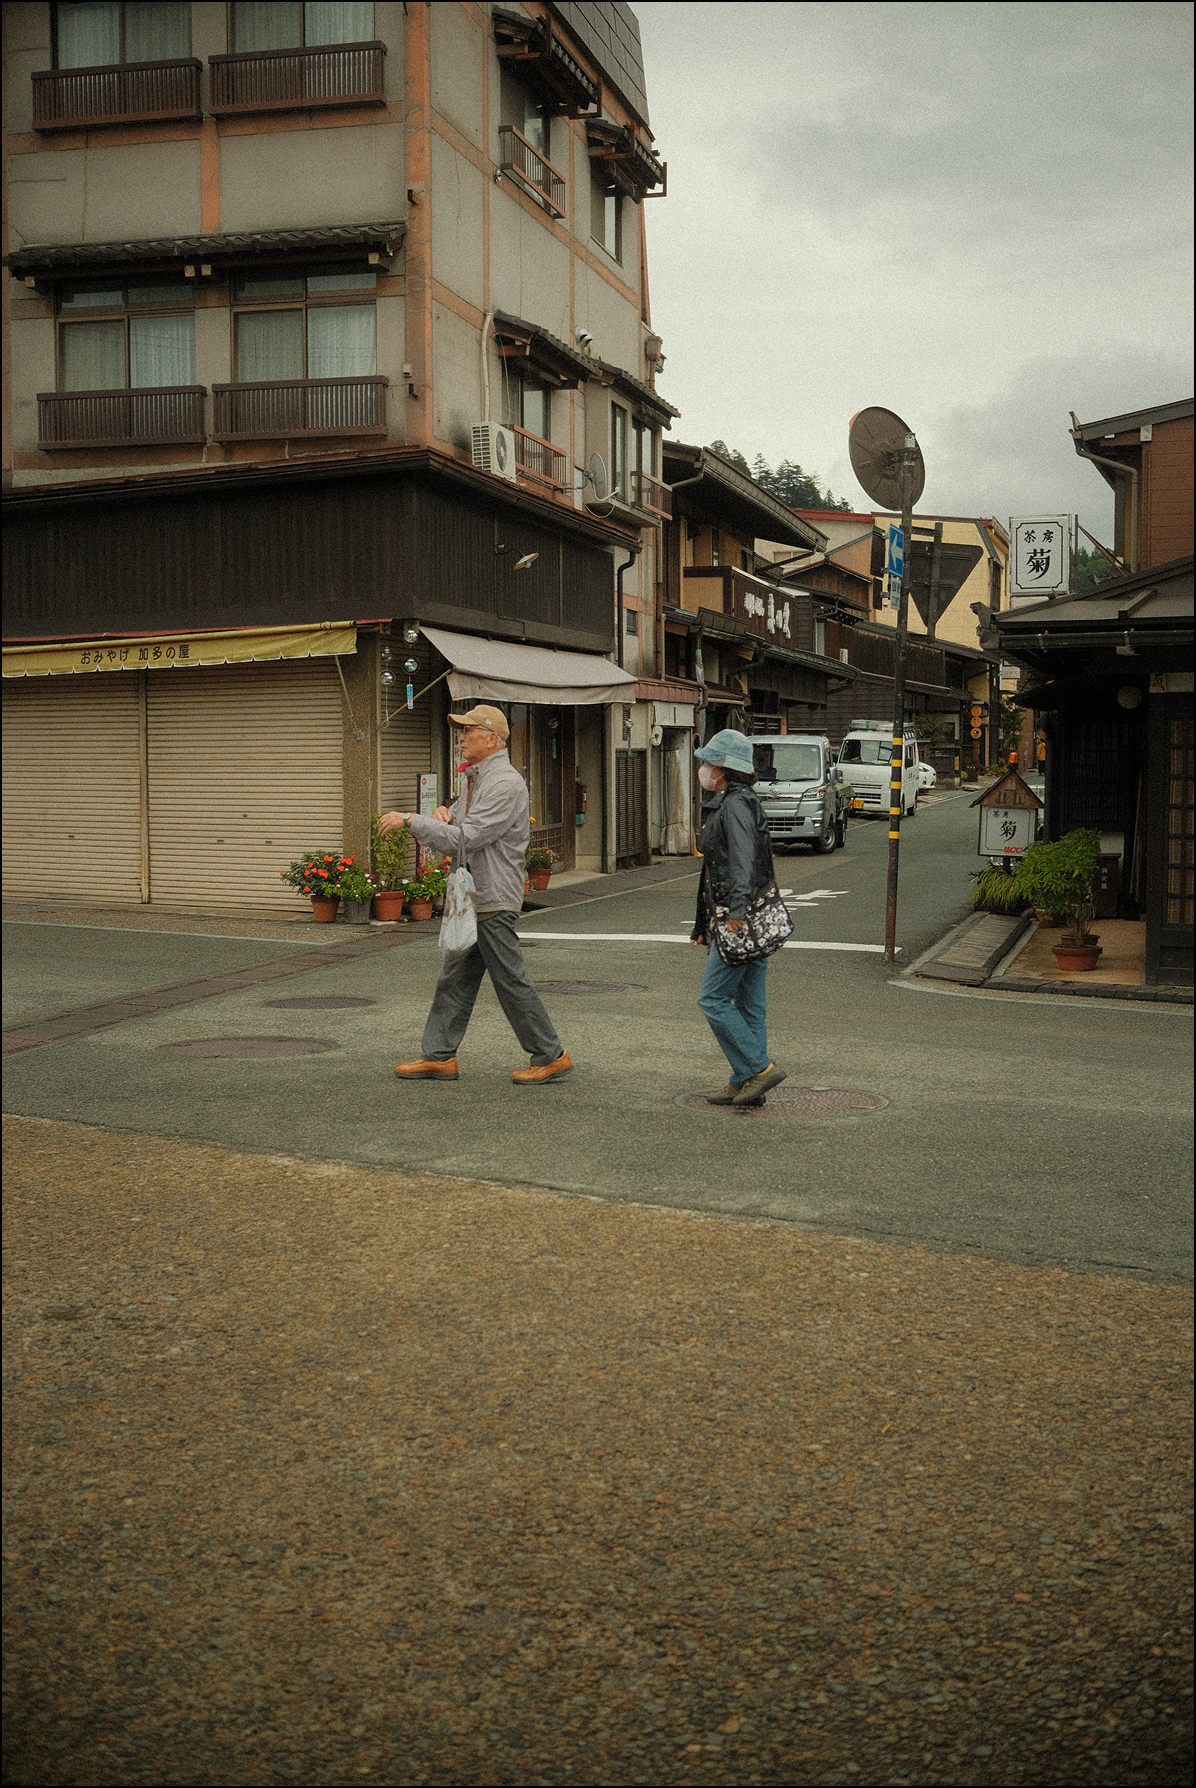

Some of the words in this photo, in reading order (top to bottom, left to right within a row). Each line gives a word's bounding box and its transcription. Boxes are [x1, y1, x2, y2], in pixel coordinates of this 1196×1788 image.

[1023, 529, 1054, 544] 茶房
[1026, 548, 1052, 581] 菊
[80, 647, 131, 665] おみやげ
[138, 644, 190, 661] 加多の屋
[1000, 820, 1017, 842] 菊
[1003, 846, 1023, 854] UCC
